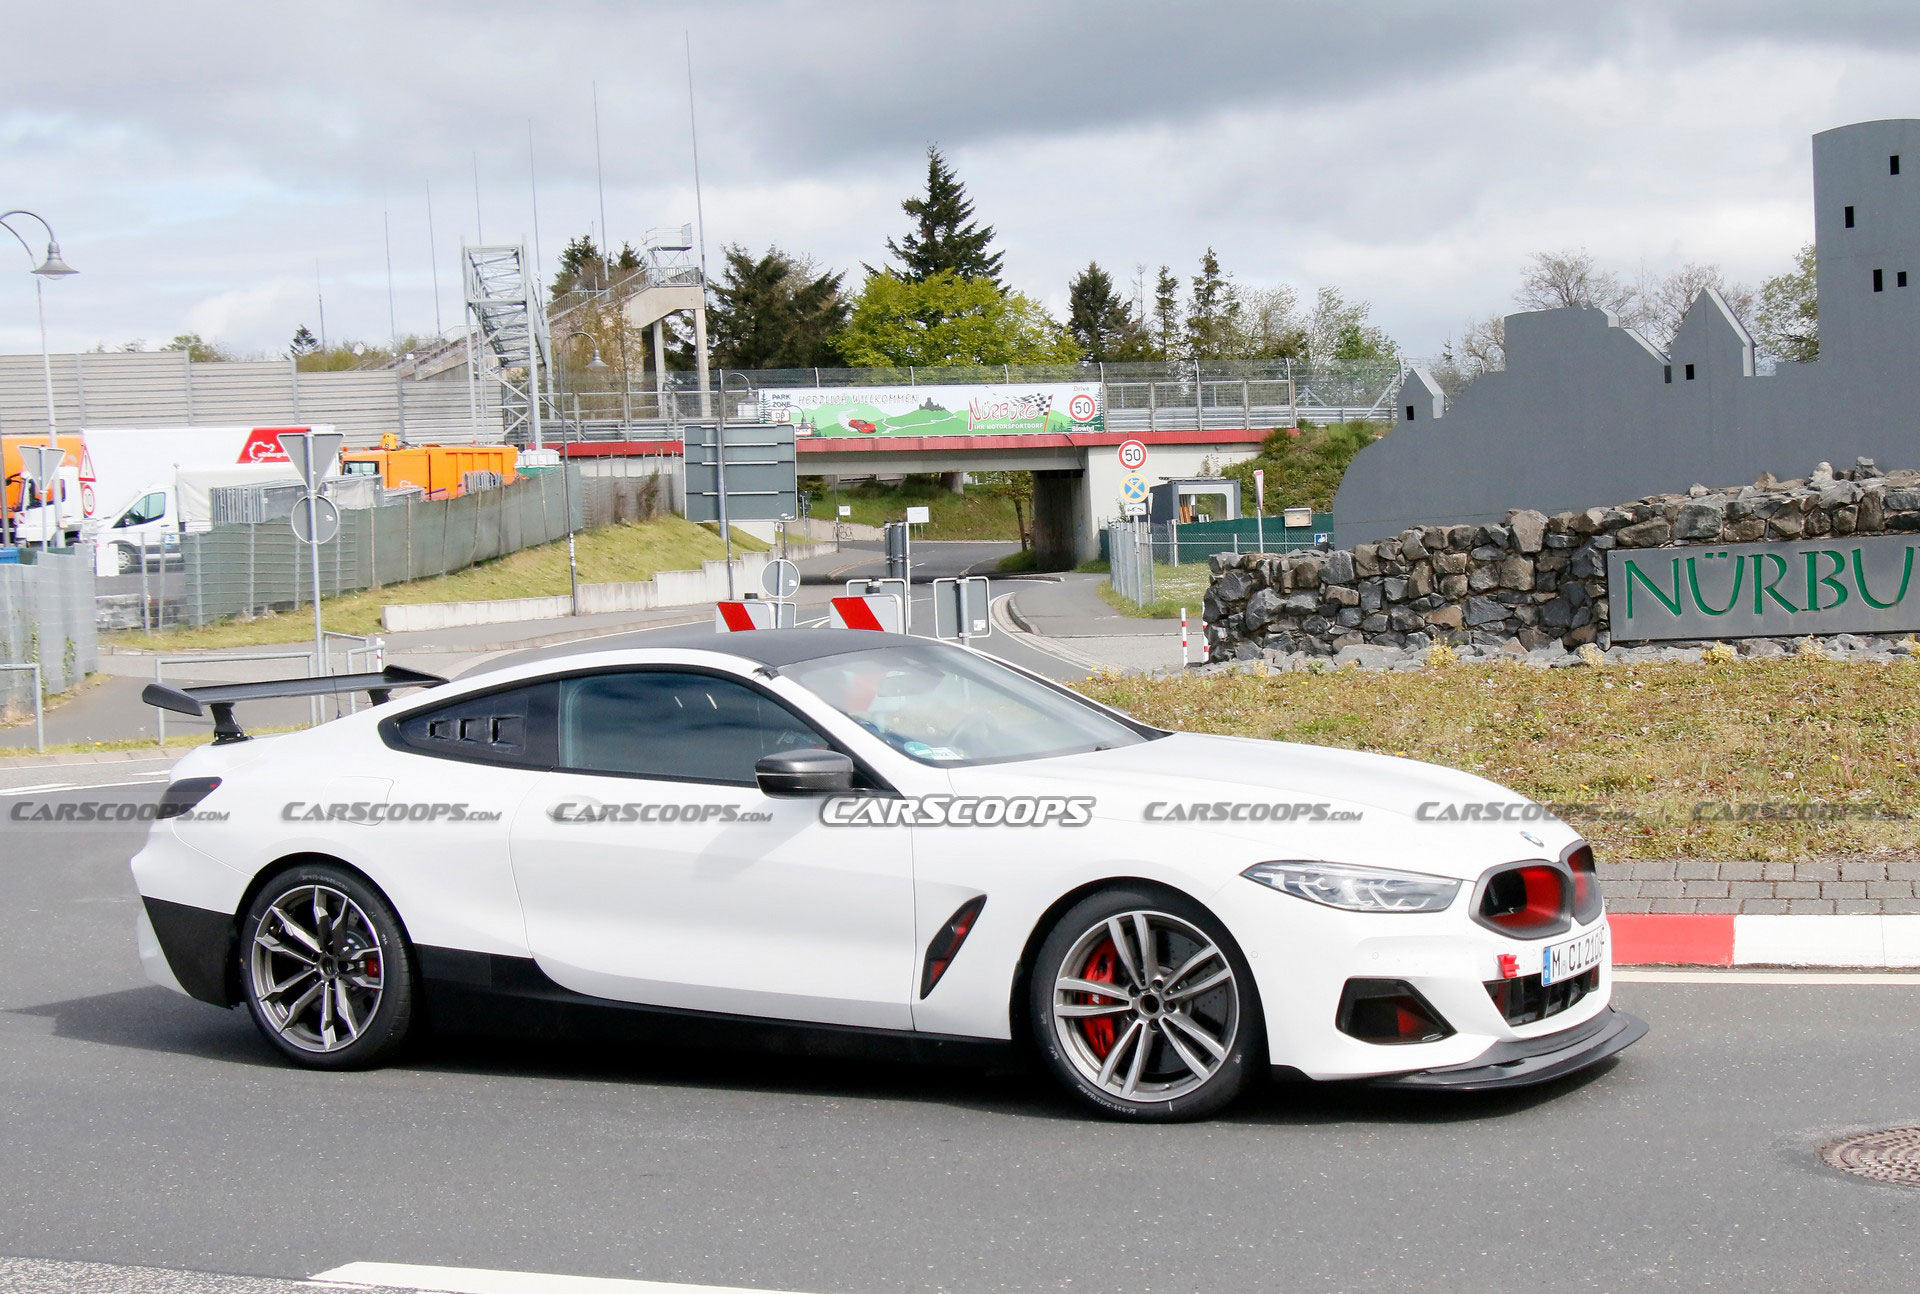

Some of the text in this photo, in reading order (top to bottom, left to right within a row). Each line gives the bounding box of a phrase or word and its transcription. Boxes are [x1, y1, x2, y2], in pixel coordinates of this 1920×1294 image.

[798, 393, 919, 405] HERZLICH WILLKOMMEN
[967, 396, 1040, 432] NÜRBURG
[1074, 401, 1091, 415] 50
[987, 422, 1043, 430] MOTORSPORTDORF
[1124, 448, 1141, 462] 50
[1624, 546, 1920, 619] NÜRBU
[1552, 949, 1560, 978] M
